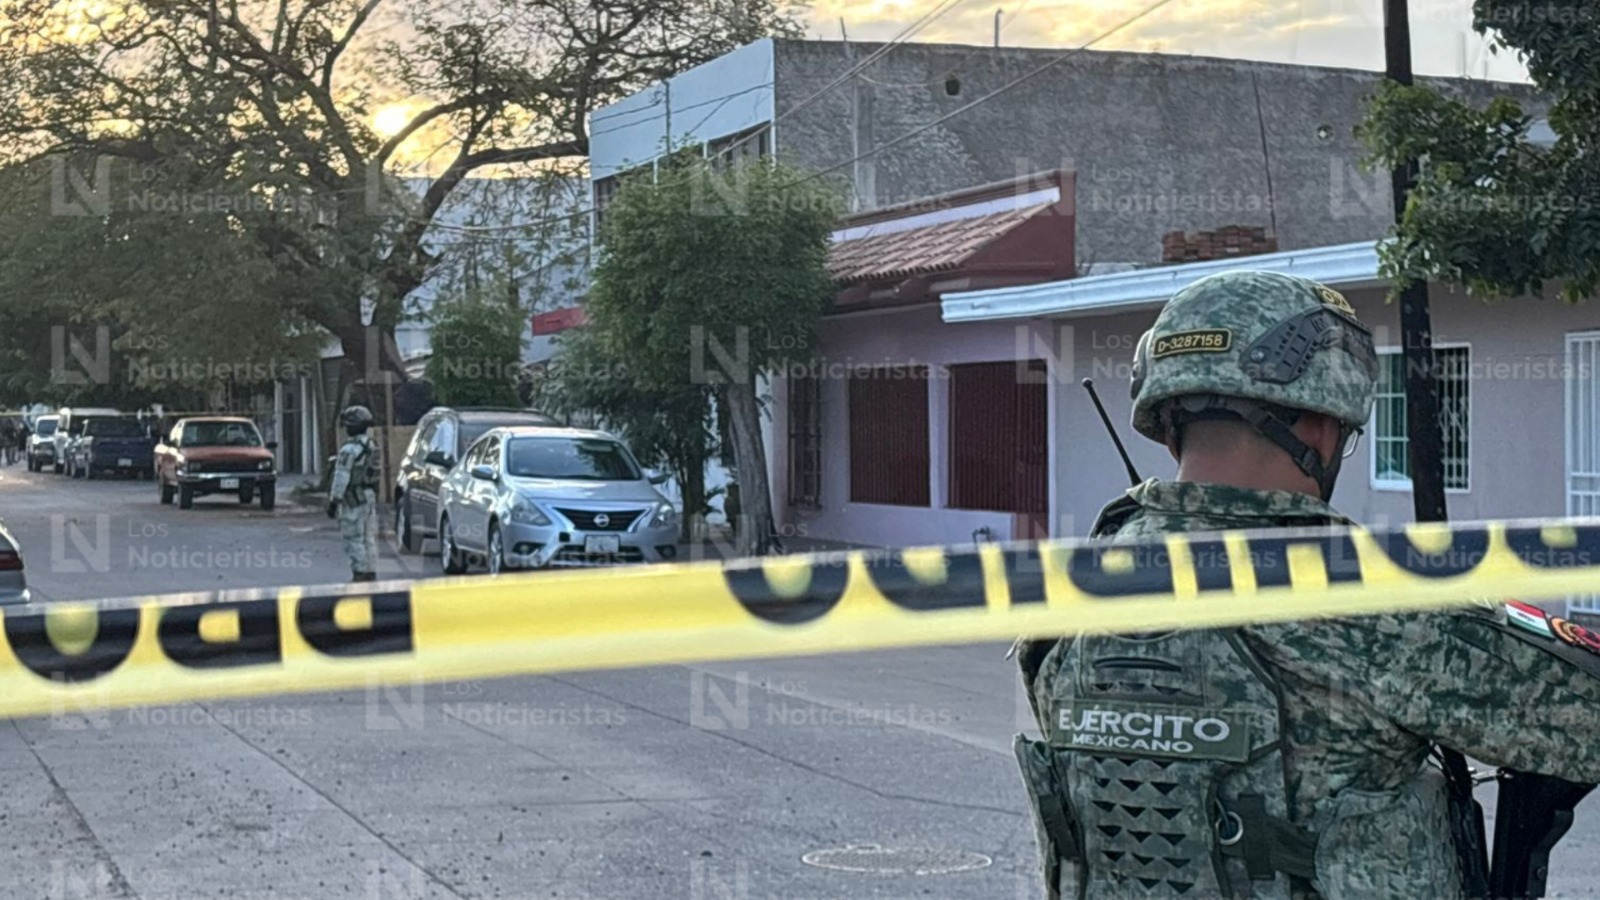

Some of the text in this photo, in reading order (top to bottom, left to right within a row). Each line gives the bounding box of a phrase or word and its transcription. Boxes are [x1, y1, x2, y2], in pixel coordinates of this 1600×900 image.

[1157, 333, 1223, 353] D-3287158
[1058, 704, 1230, 742] EJÉRCITO
[1072, 733, 1194, 753] MEXICANO
